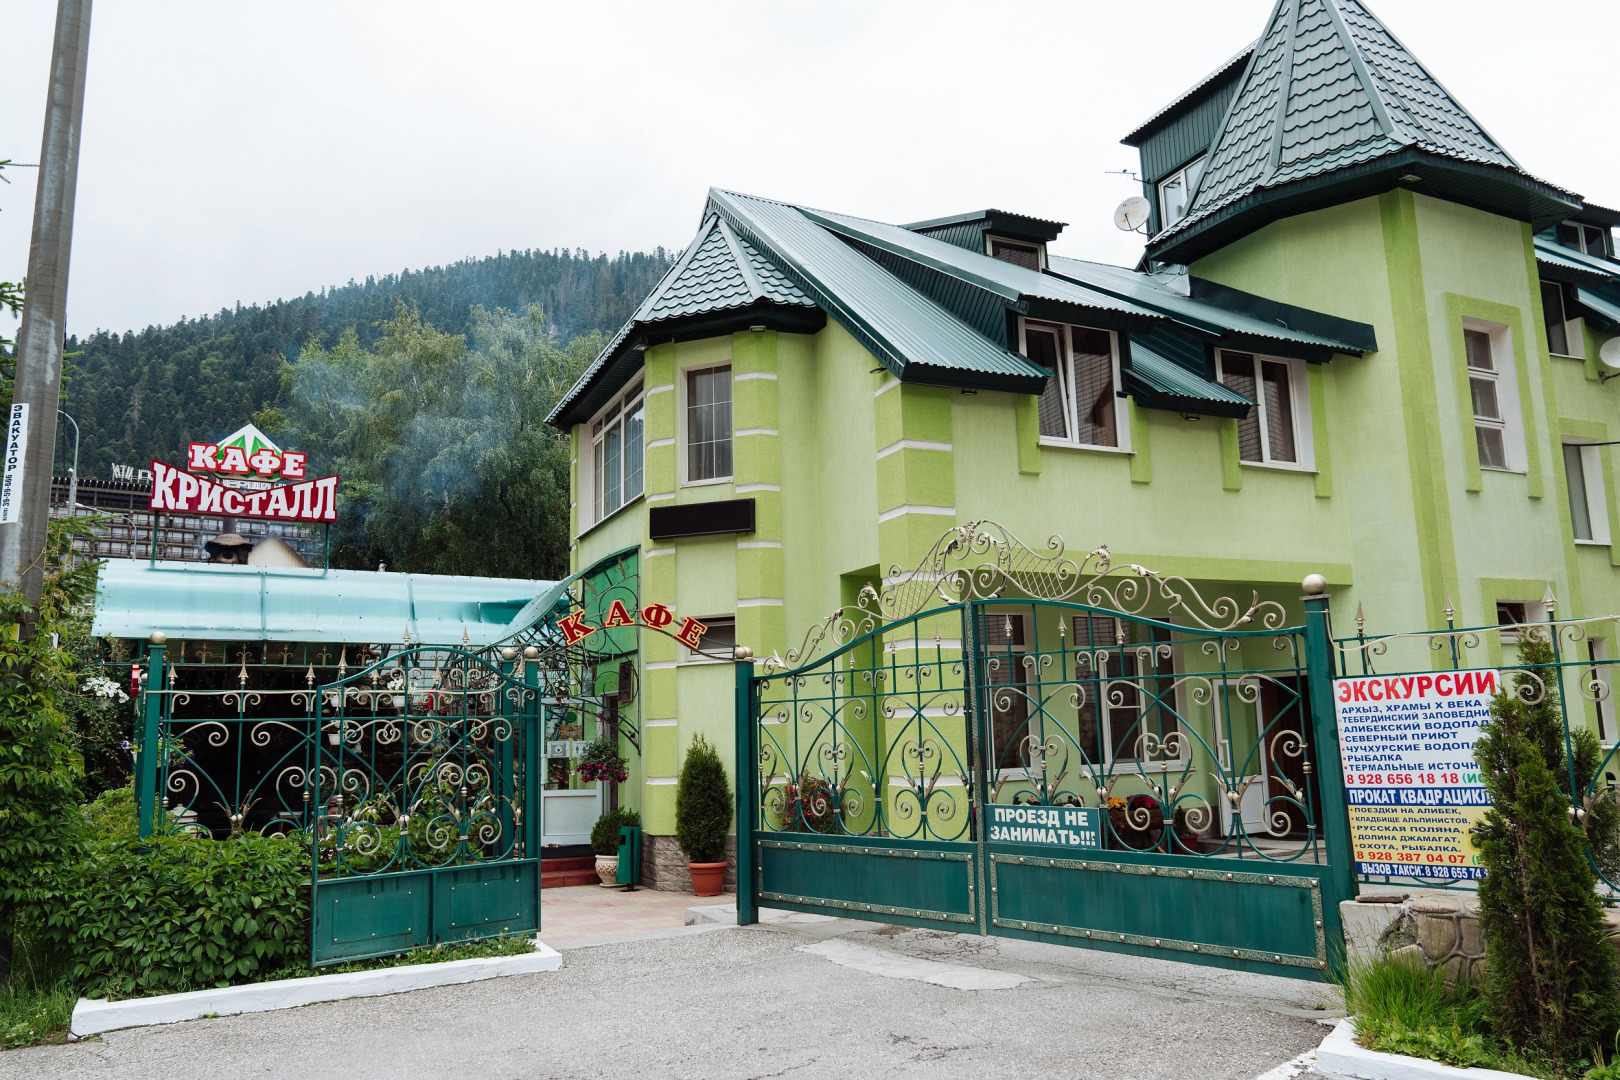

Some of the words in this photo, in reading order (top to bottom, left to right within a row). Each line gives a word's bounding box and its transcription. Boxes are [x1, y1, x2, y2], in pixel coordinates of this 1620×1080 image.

[8, 404, 23, 472] ЭВАКУАТОР
[189, 443, 306, 479] КАФЕ
[152, 462, 337, 520] КРИСТАЛЛ
[555, 600, 708, 650] КАФЕ
[1338, 671, 1496, 703] ЭКСКУРСИИ
[1342, 705, 1382, 714] АРХЫЗ,
[1386, 702, 1431, 712] ХРАМЫ
[1448, 700, 1482, 709] ВЕКА
[1342, 712, 1419, 724] ТЕБЕРДИНСКИЙ
[1422, 709, 1492, 720] ЗАПОВЕДНИ
[1344, 721, 1420, 733] АЛИБЕКСКИЙ
[1345, 732, 1408, 743] СЕВЕРНЫЙ
[1411, 731, 1459, 741] ПРИЮТ
[1346, 744, 1420, 753] ЧУЧХУРСКИЕ
[1347, 754, 1403, 762] РЫБАЛКА
[1349, 763, 1424, 772] ТЕРМАЛЬНЫЕ
[1428, 762, 1483, 771] ИСТОЧН
[1346, 774, 1354, 785] 8
[1358, 774, 1383, 785] 928
[1387, 773, 1413, 784] 656
[1417, 773, 1435, 784] 18
[1440, 772, 1459, 784] 18
[1349, 789, 1396, 804] ПРОКАТ
[994, 808, 1060, 828] ПРОЕЗД
[1064, 811, 1089, 826] НЕ
[1402, 817, 1471, 825] АЛЬПИНИСТОВ,
[990, 825, 1096, 846] ЗАНИМАТЬ!!!
[1400, 836, 1460, 844] ДЖАМАГАТ,
[1359, 843, 1398, 851] ОХОТА,
[1356, 851, 1364, 860] 8
[1368, 852, 1392, 861] 928
[1396, 852, 1421, 862] 387
[1426, 854, 1444, 863] 04
[1448, 855, 1466, 864] 07
[1361, 862, 1391, 875] ВЫЗОВ
[1426, 866, 1431, 877] 8
[1433, 867, 1449, 878] 928
[1451, 867, 1467, 879] 655
[1469, 868, 1481, 879] 74
